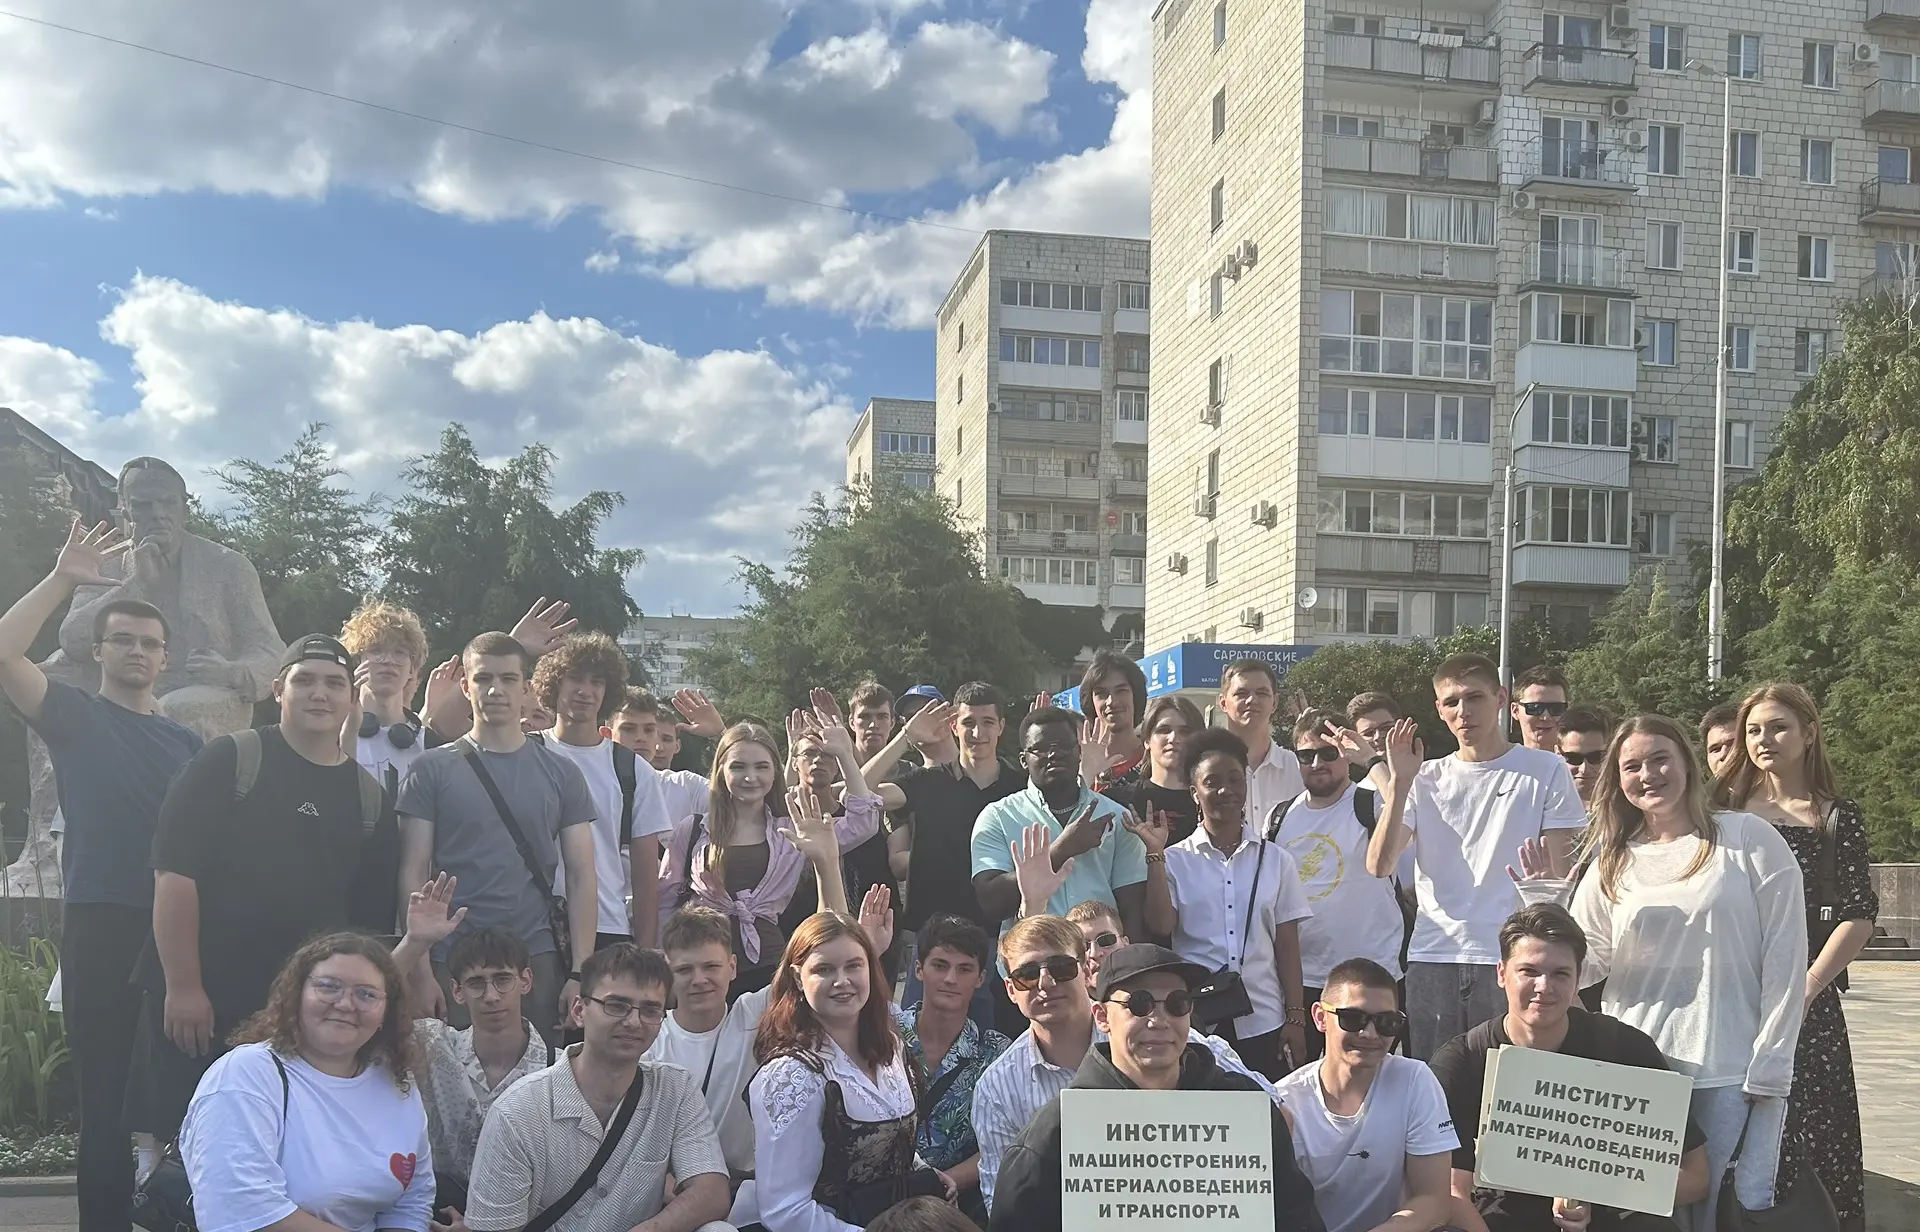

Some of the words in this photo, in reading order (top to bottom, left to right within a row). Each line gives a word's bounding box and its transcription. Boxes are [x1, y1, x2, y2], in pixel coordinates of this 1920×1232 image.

[1213, 649, 1297, 662] САРАТОВСКИЕ
[1534, 1079, 1650, 1115] ИНСТИТУТ
[1496, 1099, 1680, 1146] МАШИНОСТРОЕНИЯ,
[1106, 1123, 1230, 1143] ИНСТИТУТ
[1489, 1119, 1681, 1166] МАТЕРИАЛОВЕДЕНИЯ
[1068, 1153, 1267, 1172] МАШИНОСТРОЕНИЯ,
[1516, 1146, 1528, 1160] И
[1532, 1149, 1646, 1182] ТРАНСПОРТА
[1064, 1178, 1272, 1196] МАТЕРИАЛОВЕДЕНИЯ
[1099, 1204, 1111, 1218] И
[1116, 1204, 1240, 1219] ТРАНСПОРТА
